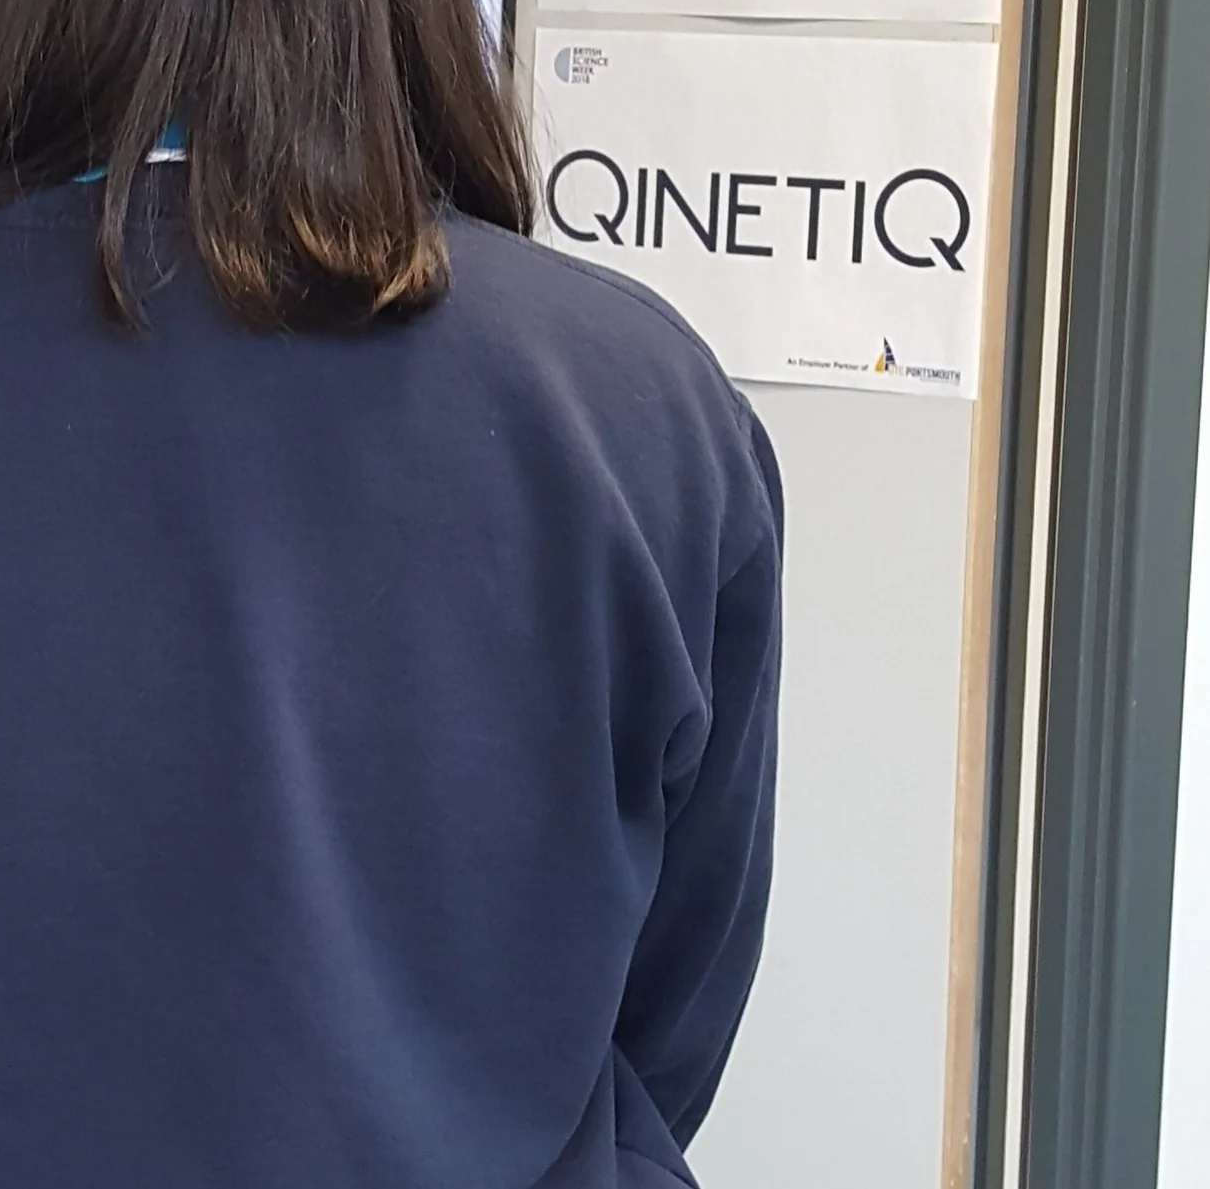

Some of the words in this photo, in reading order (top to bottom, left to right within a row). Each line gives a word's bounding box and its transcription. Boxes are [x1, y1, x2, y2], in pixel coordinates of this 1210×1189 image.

[573, 57, 608, 66] SCIENCE
[572, 67, 594, 75] WEEK
[546, 149, 971, 272] QINETIQ
[905, 366, 961, 382] PORTSMOUTH
